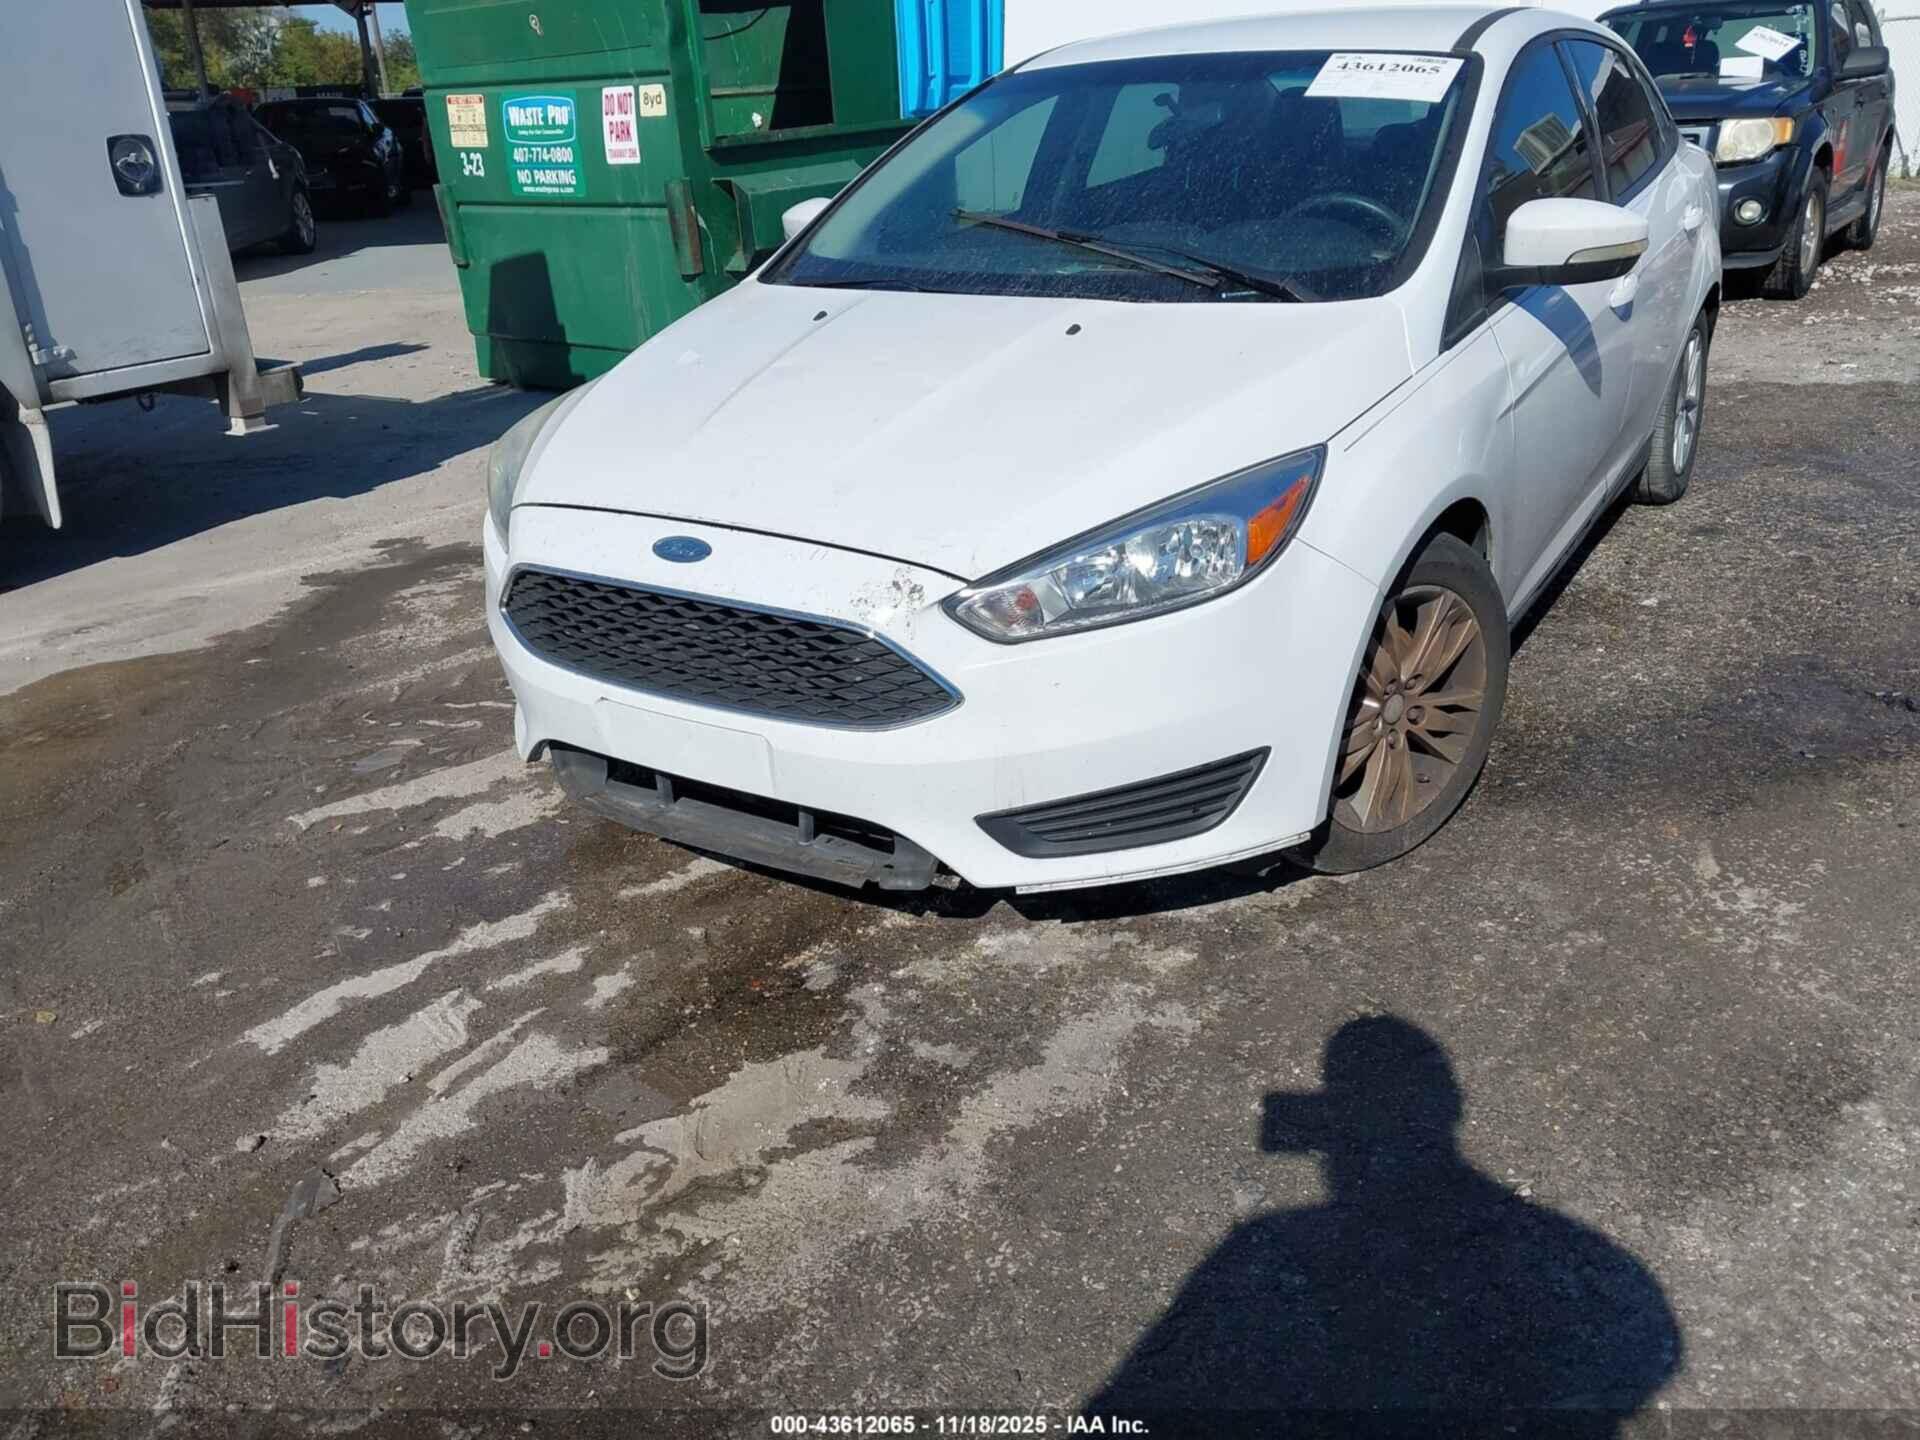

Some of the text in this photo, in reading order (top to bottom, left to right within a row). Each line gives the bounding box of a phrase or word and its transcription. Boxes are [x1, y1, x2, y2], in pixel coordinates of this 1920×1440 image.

[1336, 61, 1441, 74] 43612065
[605, 92, 633, 116] DO NOT
[643, 91, 662, 108] 8yd
[508, 106, 544, 126] WASTE
[609, 120, 633, 142] PARK
[513, 147, 574, 163] 407-774-0800
[460, 152, 485, 177] 3-23
[517, 169, 577, 185] NO PARKING
